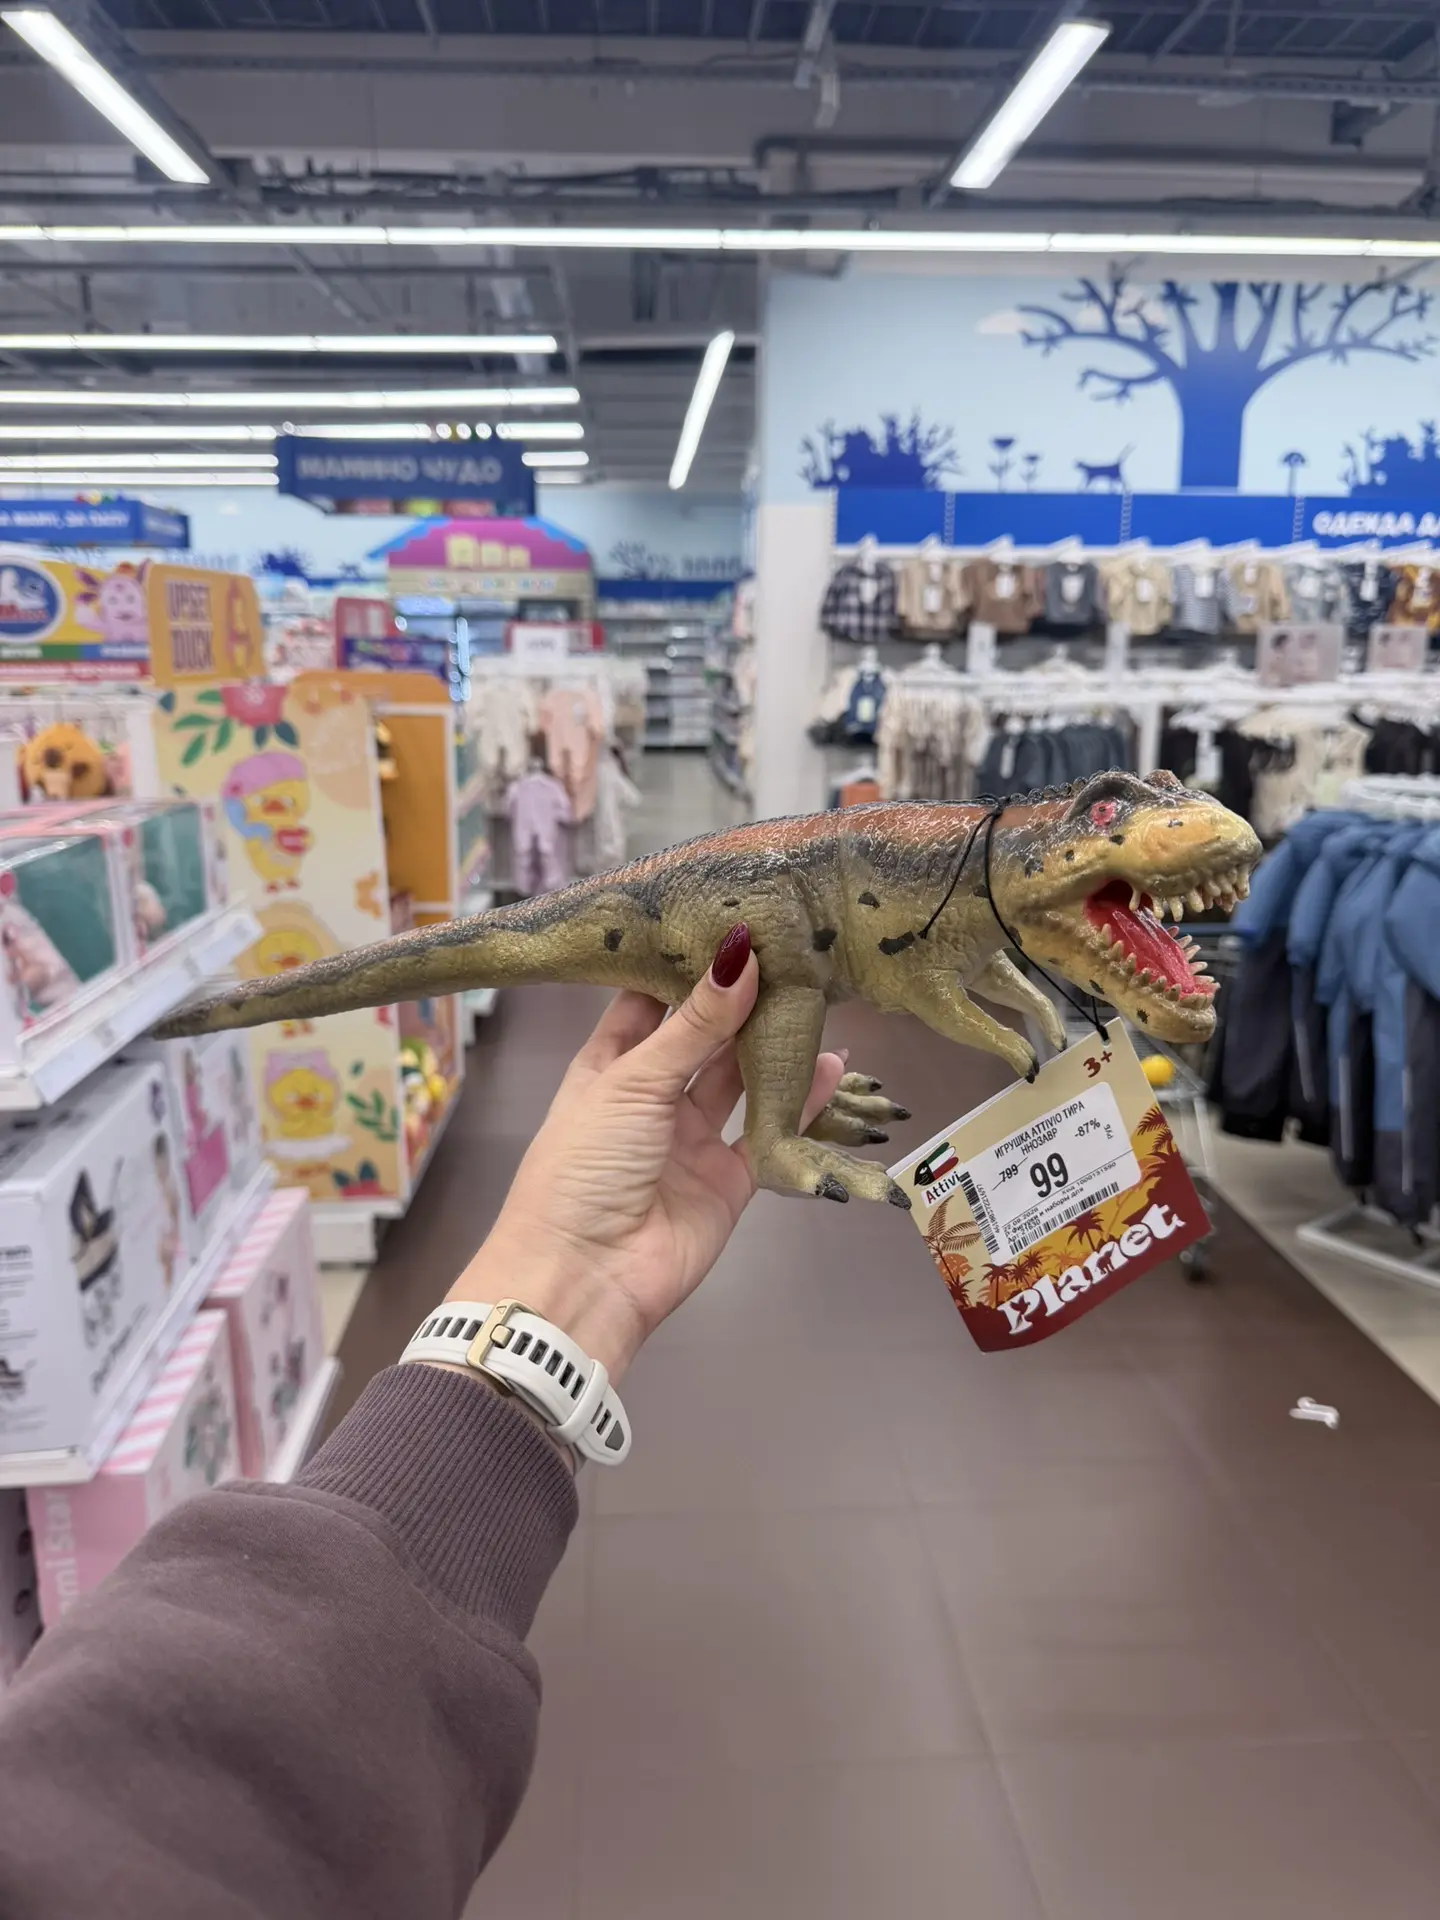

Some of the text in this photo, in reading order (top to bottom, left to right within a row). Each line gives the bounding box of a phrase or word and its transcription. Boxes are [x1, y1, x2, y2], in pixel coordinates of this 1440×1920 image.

[1312, 510, 1440, 537] ОДЕЖДА Д
[1083, 1050, 1113, 1079] 3+
[994, 1100, 1085, 1159] ИГРУШКА ATTIVIO ТИРА
[1074, 1118, 1101, 1138] -87%
[925, 1170, 961, 1204] Attivi
[998, 1163, 1019, 1183] 799
[1029, 1152, 1069, 1198] 99
[1044, 1196, 1070, 1213] наборы
[1070, 1187, 1084, 1201] для
[997, 1202, 1186, 1335] Planet
